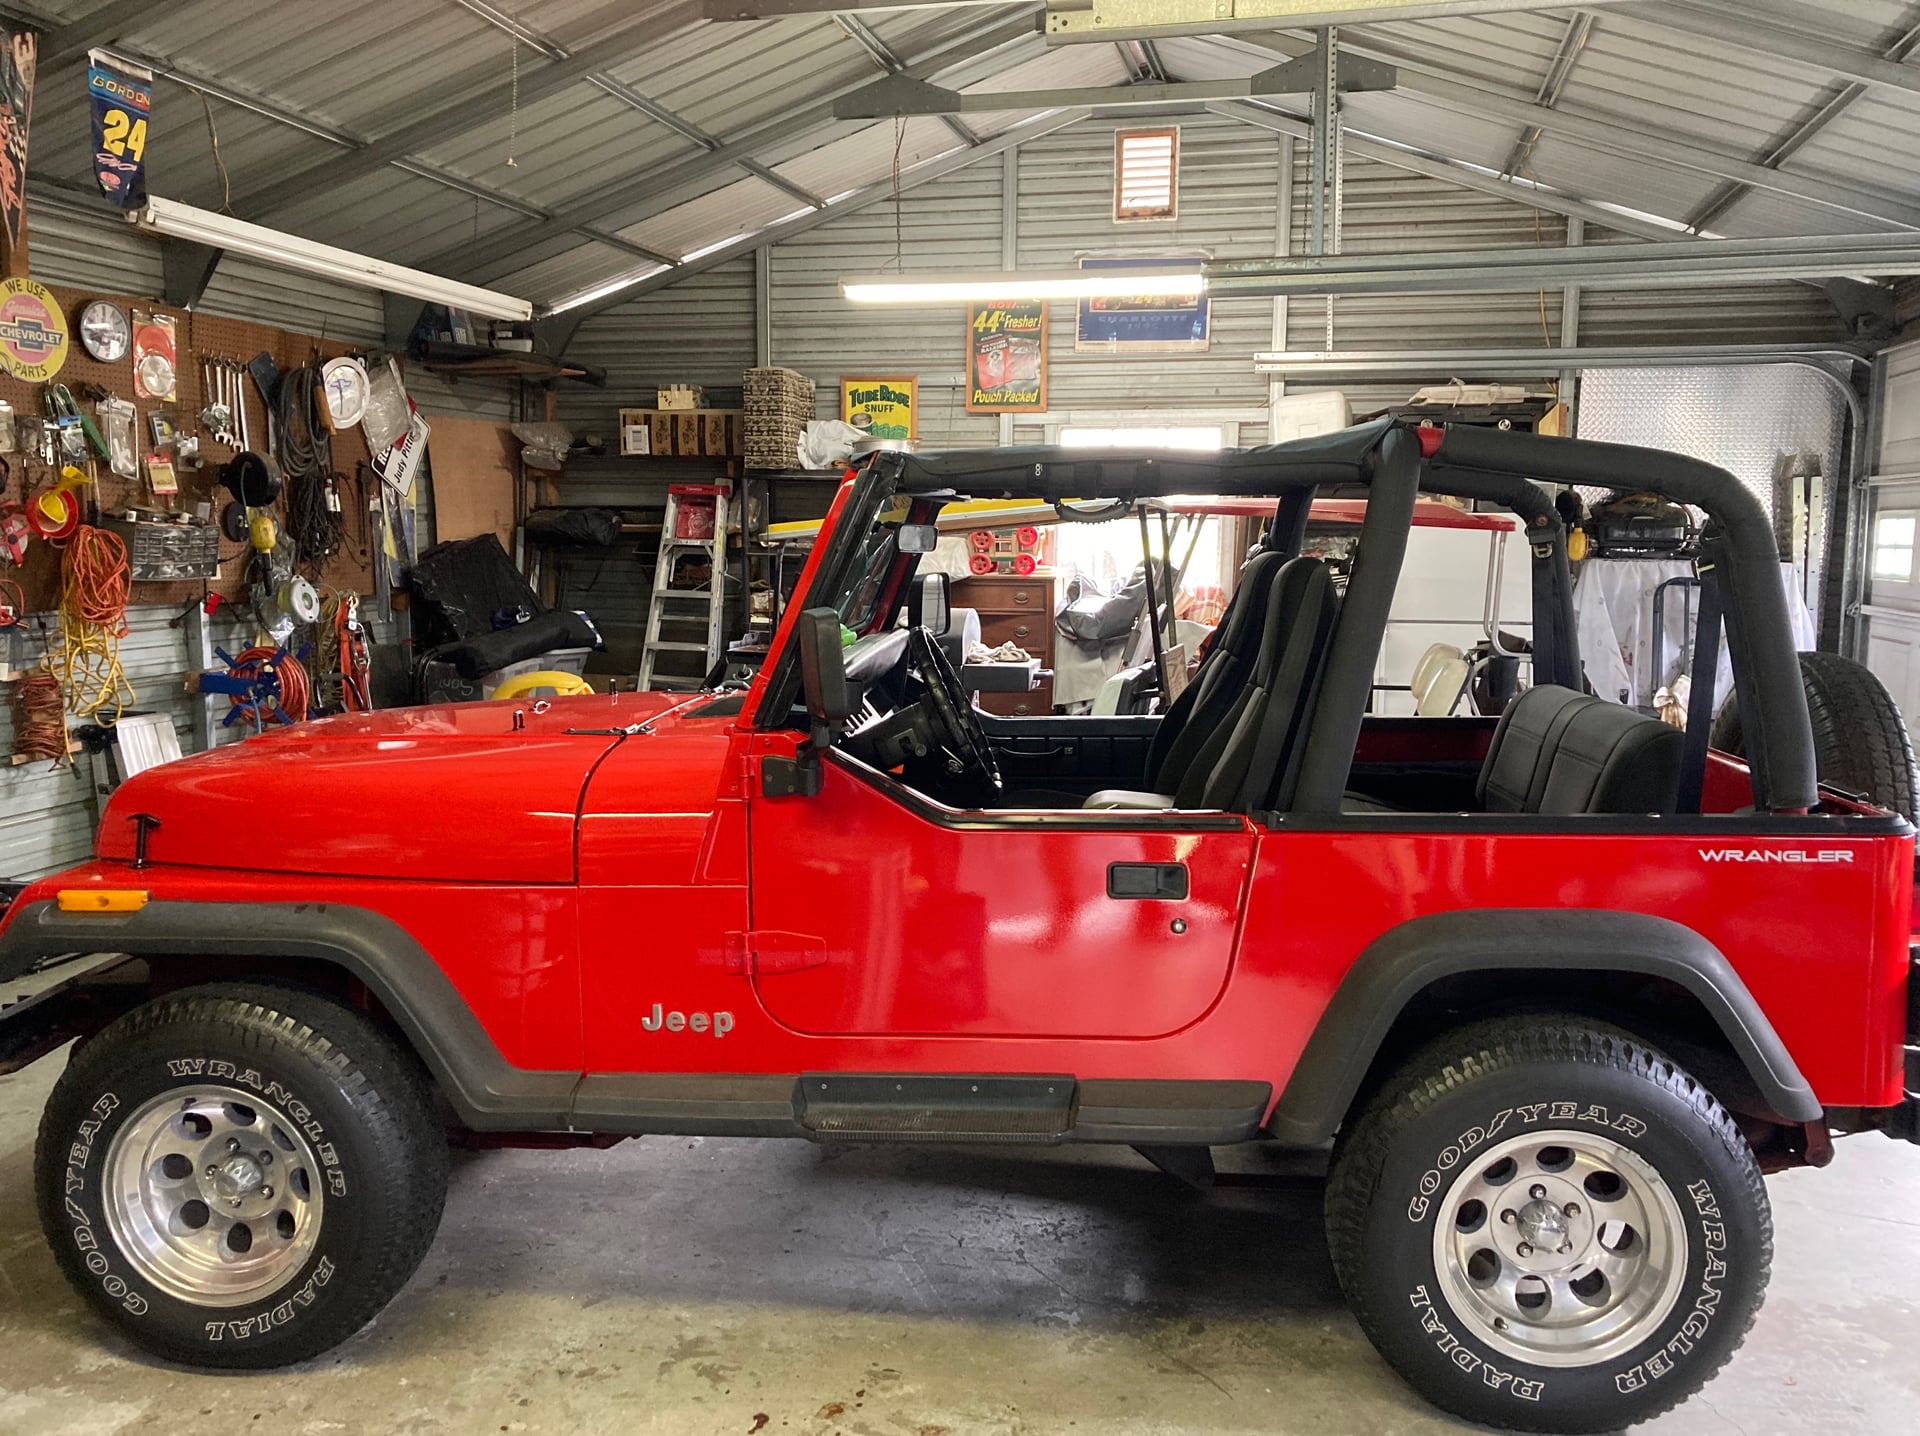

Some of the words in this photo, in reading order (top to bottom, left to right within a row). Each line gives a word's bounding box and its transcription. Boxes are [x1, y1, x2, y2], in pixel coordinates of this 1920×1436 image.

[93, 75, 150, 105] GORDON
[103, 109, 147, 162] 24
[5, 280, 22, 294] WE
[26, 281, 46, 300] USE
[1004, 314, 1042, 328] Fresher!
[1098, 314, 1188, 323] CHARLOTTE
[0, 326, 61, 344] CHEVROLET
[14, 361, 47, 377] PARTS
[974, 389, 1002, 403] Pouch
[1004, 388, 1039, 403] Packed
[864, 404, 894, 413] SNUFF
[394, 459, 408, 483] Judy
[1698, 849, 1854, 862] WRANGLER
[641, 1003, 735, 1038] Jeep
[168, 1059, 347, 1198] WRANGLER
[206, 1255, 335, 1341] RADIAL
[1614, 1179, 1727, 1395] WRANGLER
[1409, 1285, 1545, 1401] RADIAL
